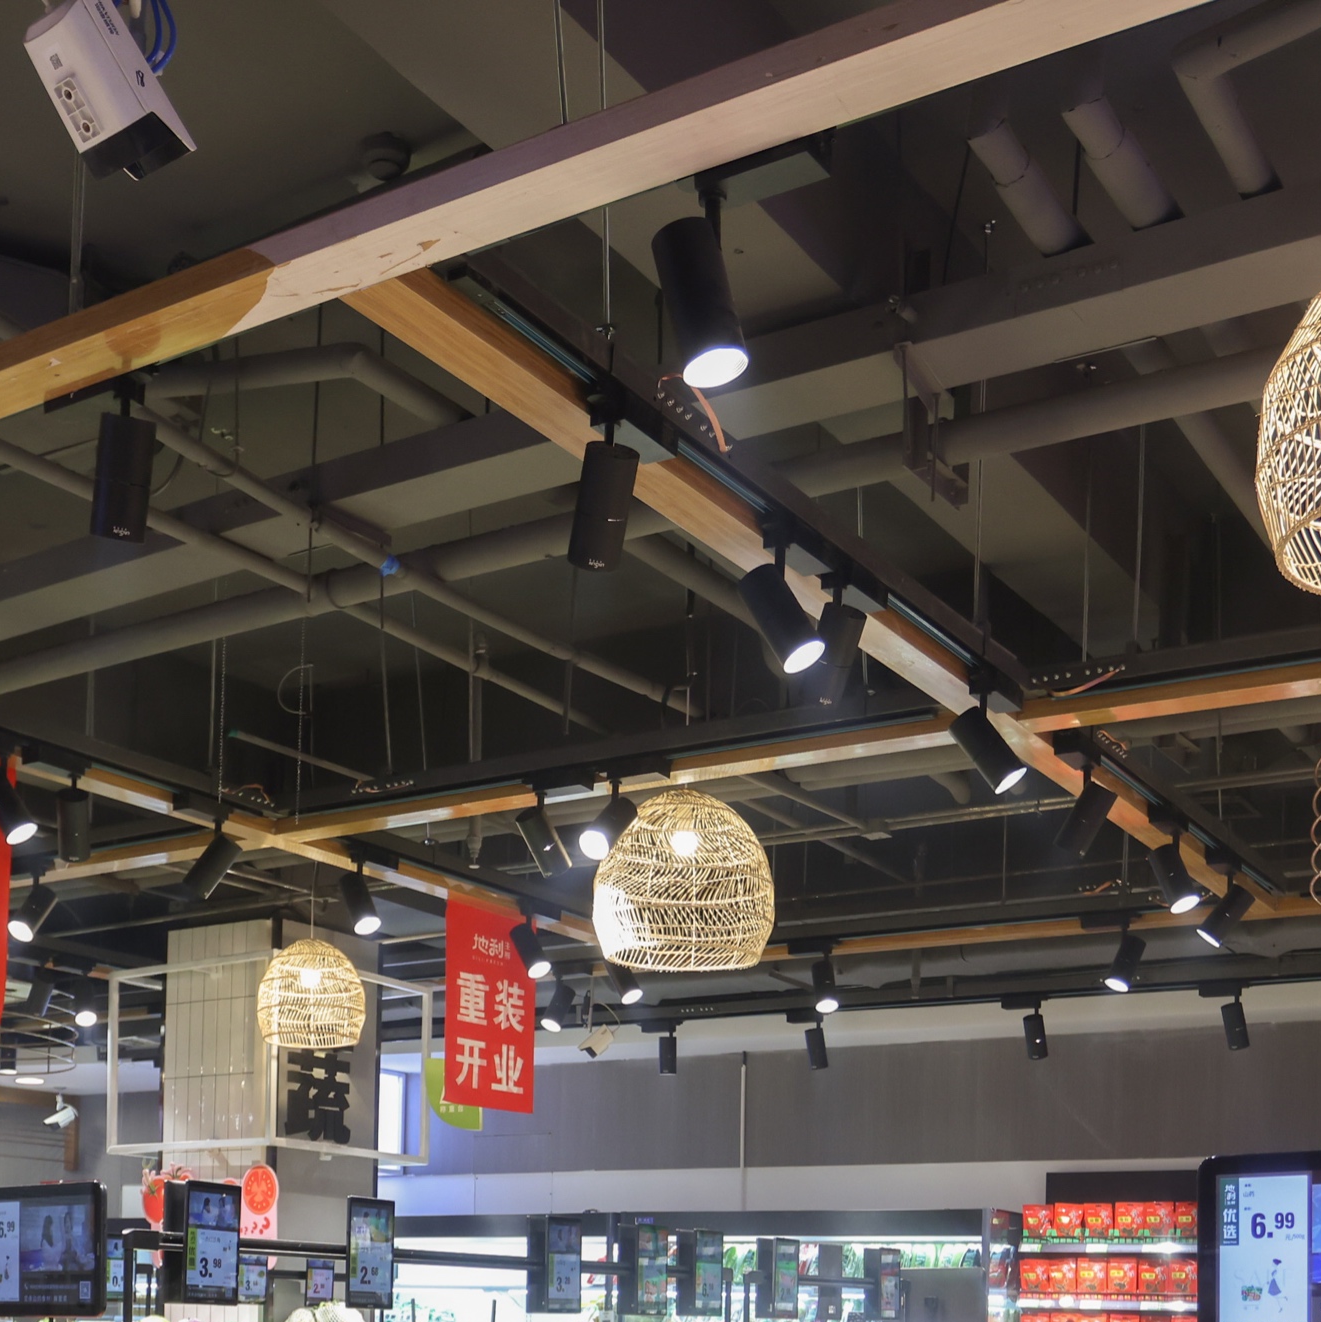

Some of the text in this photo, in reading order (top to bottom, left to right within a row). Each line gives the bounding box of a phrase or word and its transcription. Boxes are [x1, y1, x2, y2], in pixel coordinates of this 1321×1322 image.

[456, 971, 526, 1033] 重装
[455, 1036, 524, 1095] 开业
[284, 1047, 351, 1145] 蔬
[1223, 1208, 1237, 1240] 优选
[1251, 1212, 1295, 1239] 6.99
[199, 1257, 222, 1278] 3.98
